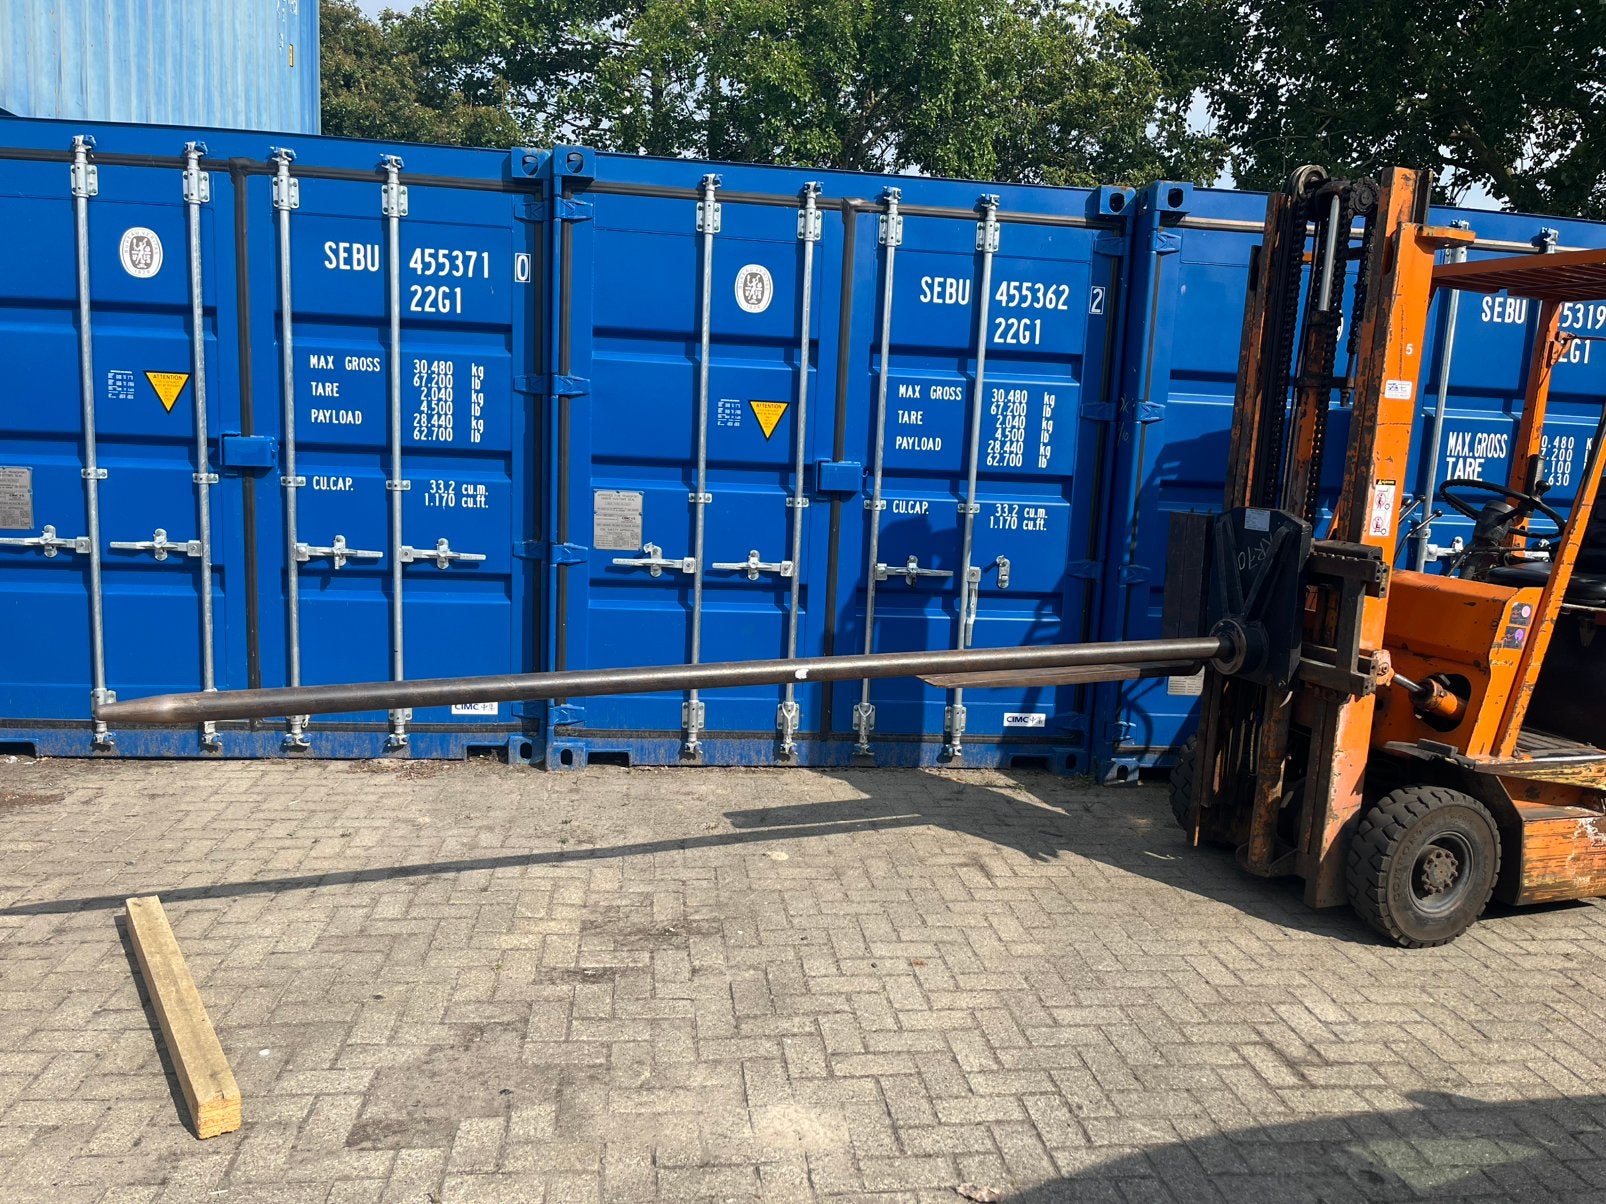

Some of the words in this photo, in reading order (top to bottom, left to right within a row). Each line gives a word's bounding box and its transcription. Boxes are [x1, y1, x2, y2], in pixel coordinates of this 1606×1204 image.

[325, 242, 380, 272] SEBU
[410, 248, 488, 278] 455371
[516, 254, 529, 281] 0
[411, 285, 461, 314] 22G1
[920, 277, 971, 306] SEBU
[996, 281, 1070, 310] 455362
[1090, 288, 1103, 313] 2
[1482, 297, 1526, 324] SEBU
[1558, 302, 1606, 329] 5319
[994, 318, 1040, 345] 22G1
[1405, 343, 1414, 355] 5
[309, 354, 335, 370] MAX
[346, 356, 380, 372] GROSS
[413, 359, 453, 375] 30.480
[472, 363, 484, 380] kg
[413, 374, 453, 388] 67.200
[472, 377, 481, 390] lb
[311, 381, 340, 397] TARE
[420, 387, 453, 401] 2.040
[472, 390, 484, 406] kg
[899, 384, 921, 399] MAX
[931, 386, 962, 401] GROSS
[991, 389, 1028, 403] 30.480
[1044, 392, 1056, 408] kg
[420, 401, 453, 415] 4.500
[472, 403, 481, 416] lb
[990, 402, 1027, 416] 67.200
[1043, 405, 1052, 417] lb
[312, 409, 363, 425] PAYLOAD
[413, 414, 453, 428] 28.440
[472, 416, 484, 433] kg
[898, 410, 924, 425] TARE
[996, 415, 1026, 429] 2.040
[1042, 418, 1054, 434] kg
[413, 427, 453, 442] 62.700
[472, 430, 481, 442] lb
[995, 428, 1025, 441] 4.500
[1041, 430, 1050, 442] lb
[896, 436, 942, 451] PAYLOAD
[987, 440, 1024, 454] 28.440
[1040, 443, 1052, 459] kg
[1447, 432, 1508, 459] MAX.GROSS
[986, 453, 1023, 467] 62.700
[1039, 456, 1048, 469] lb
[1447, 457, 1484, 481] TARE
[313, 476, 354, 491] CU.CAP.
[430, 480, 456, 494] 33.2
[462, 483, 488, 495] cu.m.
[425, 493, 456, 507] 1.170
[462, 496, 488, 508] cu.ft.
[893, 499, 929, 515] CU.CAP.
[995, 504, 1019, 517] 33.2
[1024, 507, 1048, 519] cu.m.
[990, 516, 1018, 529] 1.170
[1023, 519, 1047, 531] cu.ft.
[454, 703, 479, 711] CIMC
[1006, 715, 1029, 723] CIMC
